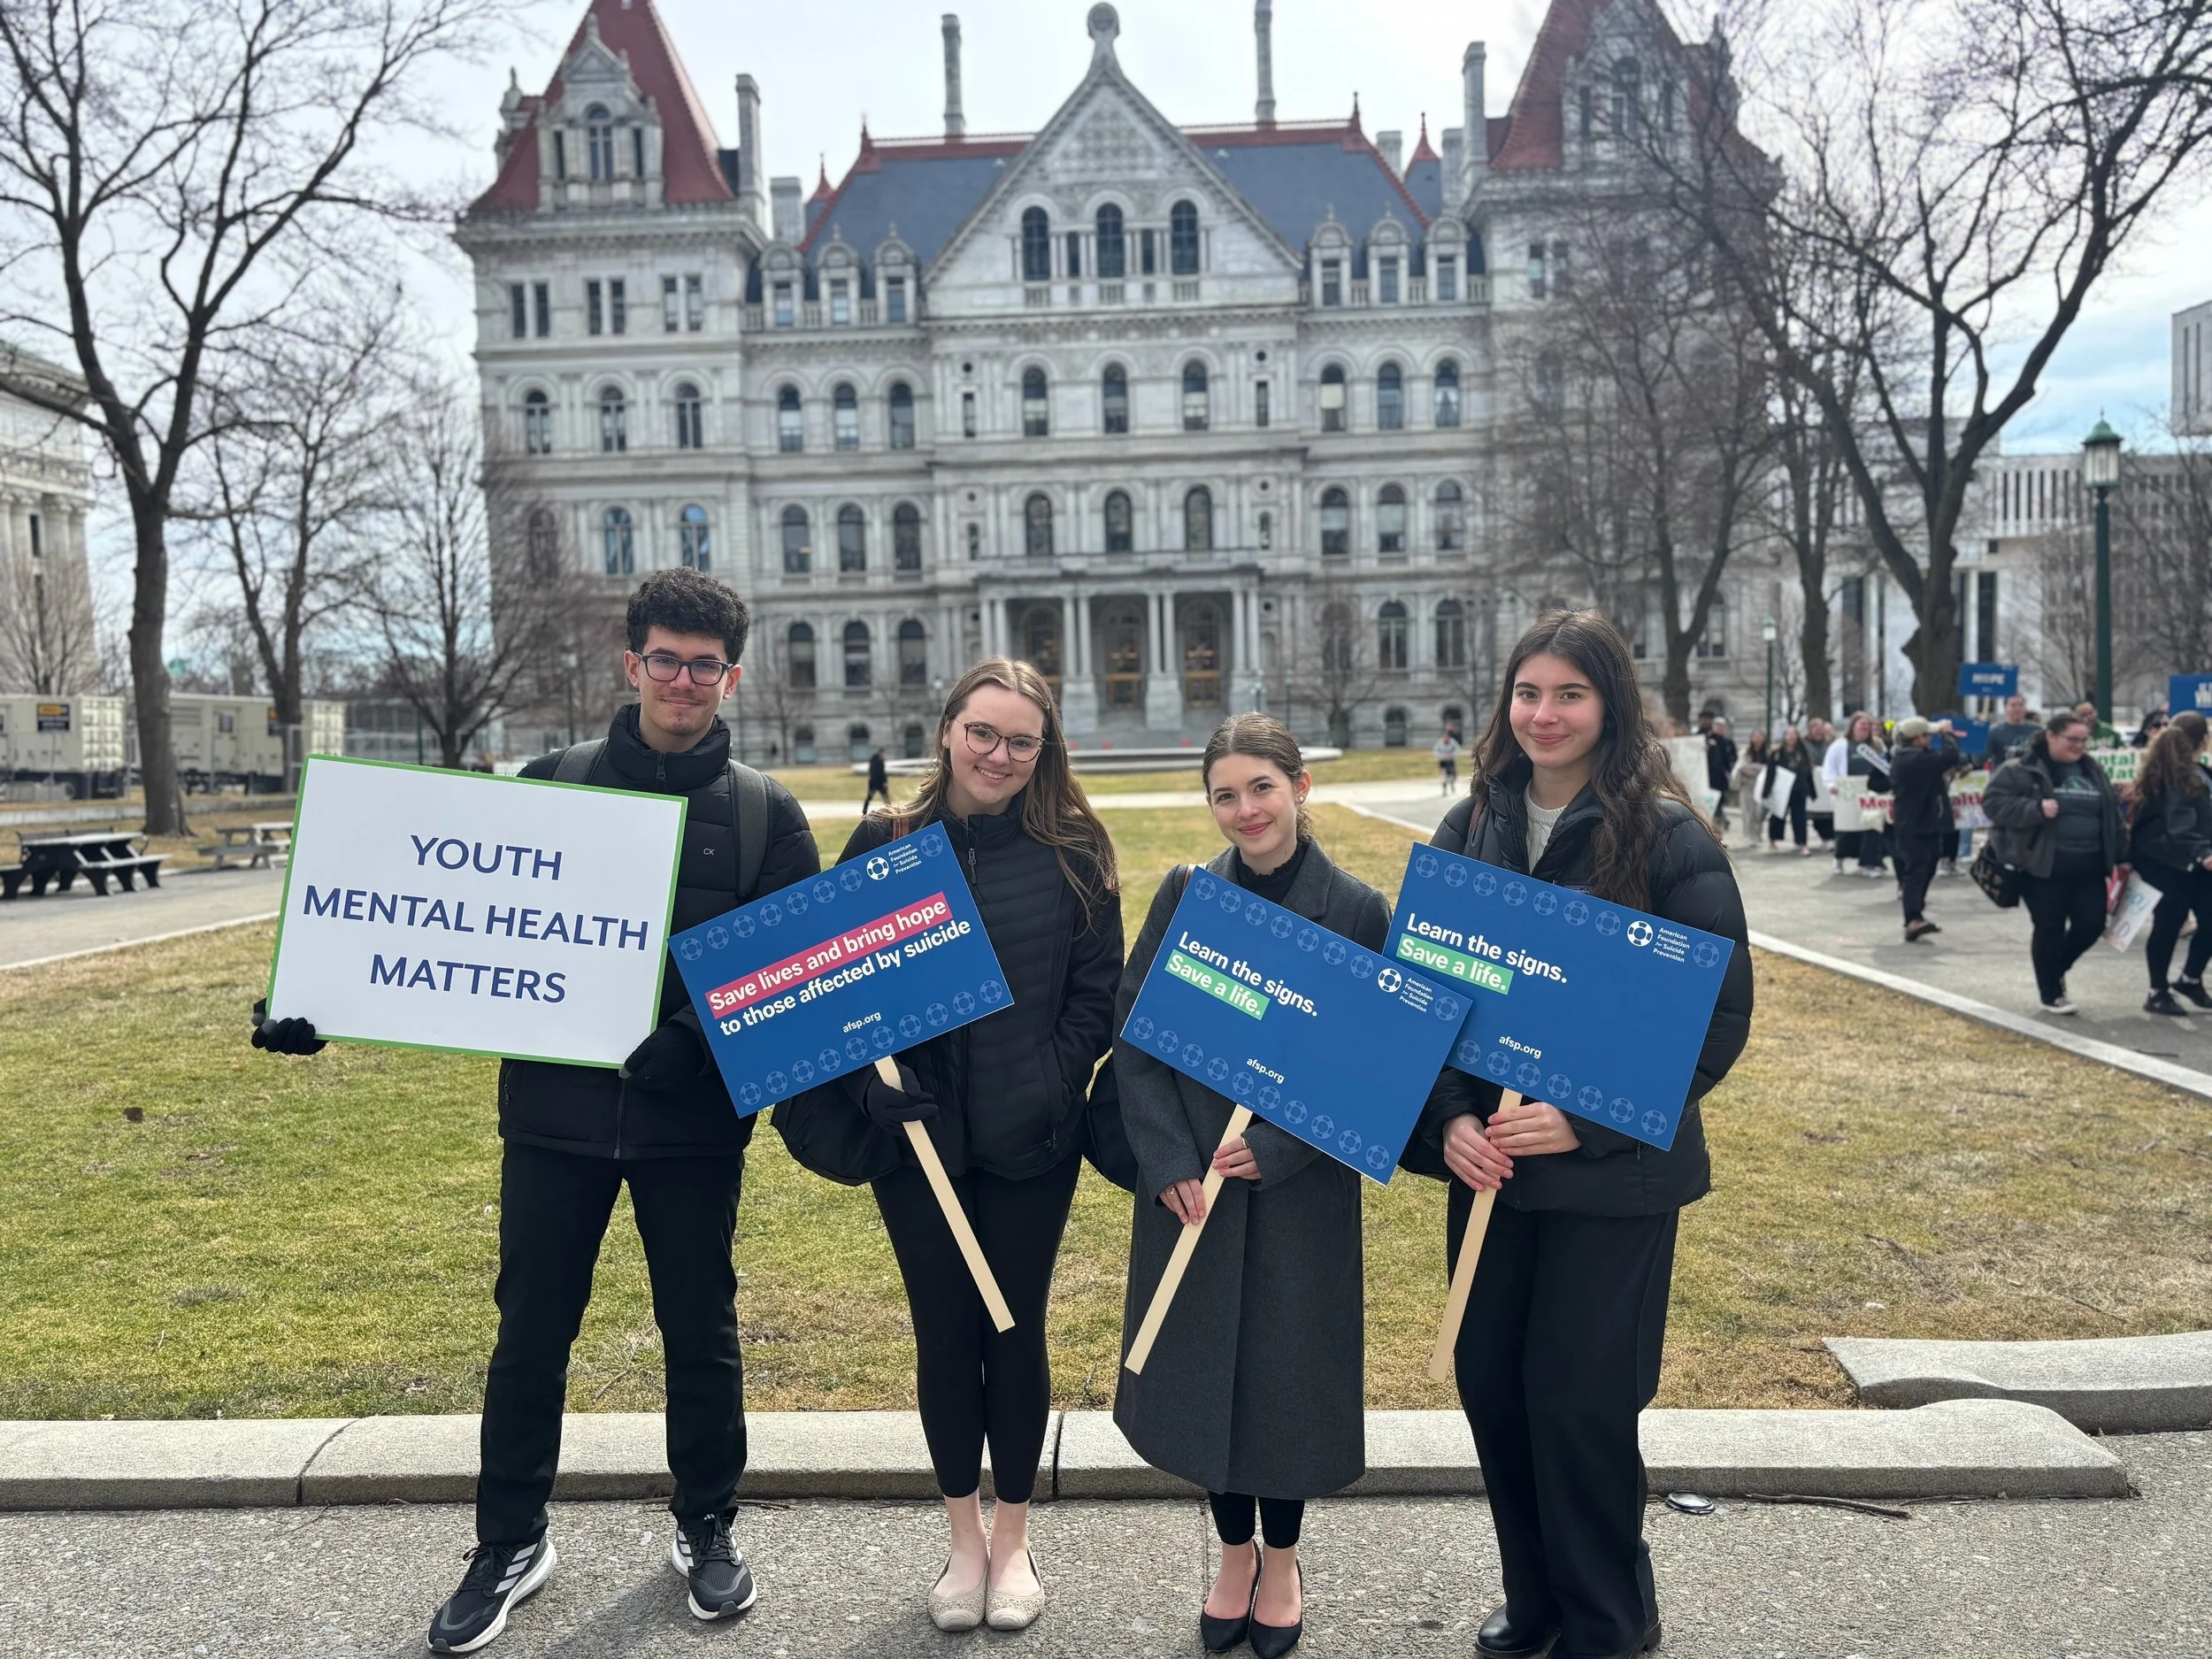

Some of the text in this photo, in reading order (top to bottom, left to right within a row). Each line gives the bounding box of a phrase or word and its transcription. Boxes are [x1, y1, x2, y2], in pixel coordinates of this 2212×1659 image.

[410, 834, 563, 881] YOUTH
[303, 885, 649, 951] MENTAL HEALTH
[1656, 933, 1690, 949] Foundation
[1658, 927, 1687, 941] American
[710, 901, 947, 1010] Save lives and bring hope
[1407, 912, 1567, 984] Learn the signs.
[1653, 948, 1685, 963] Prevention
[1663, 943, 1685, 956] Suicide
[1179, 931, 1317, 1017] Learn the signs.
[1400, 938, 1506, 991] Save a life.
[370, 954, 566, 1003] MATTERS
[719, 919, 972, 1036] to those affected by suicide
[1169, 954, 1261, 1016] Save a life.
[1407, 977, 1432, 993] American
[1399, 995, 1427, 1013] Prevention
[1404, 983, 1433, 1002] Foundation
[1408, 992, 1428, 1006] Suicide
[842, 1011, 881, 1033] afsp.org
[1499, 1036, 1542, 1059] afsp.org
[1246, 1058, 1285, 1084] afsp.org
